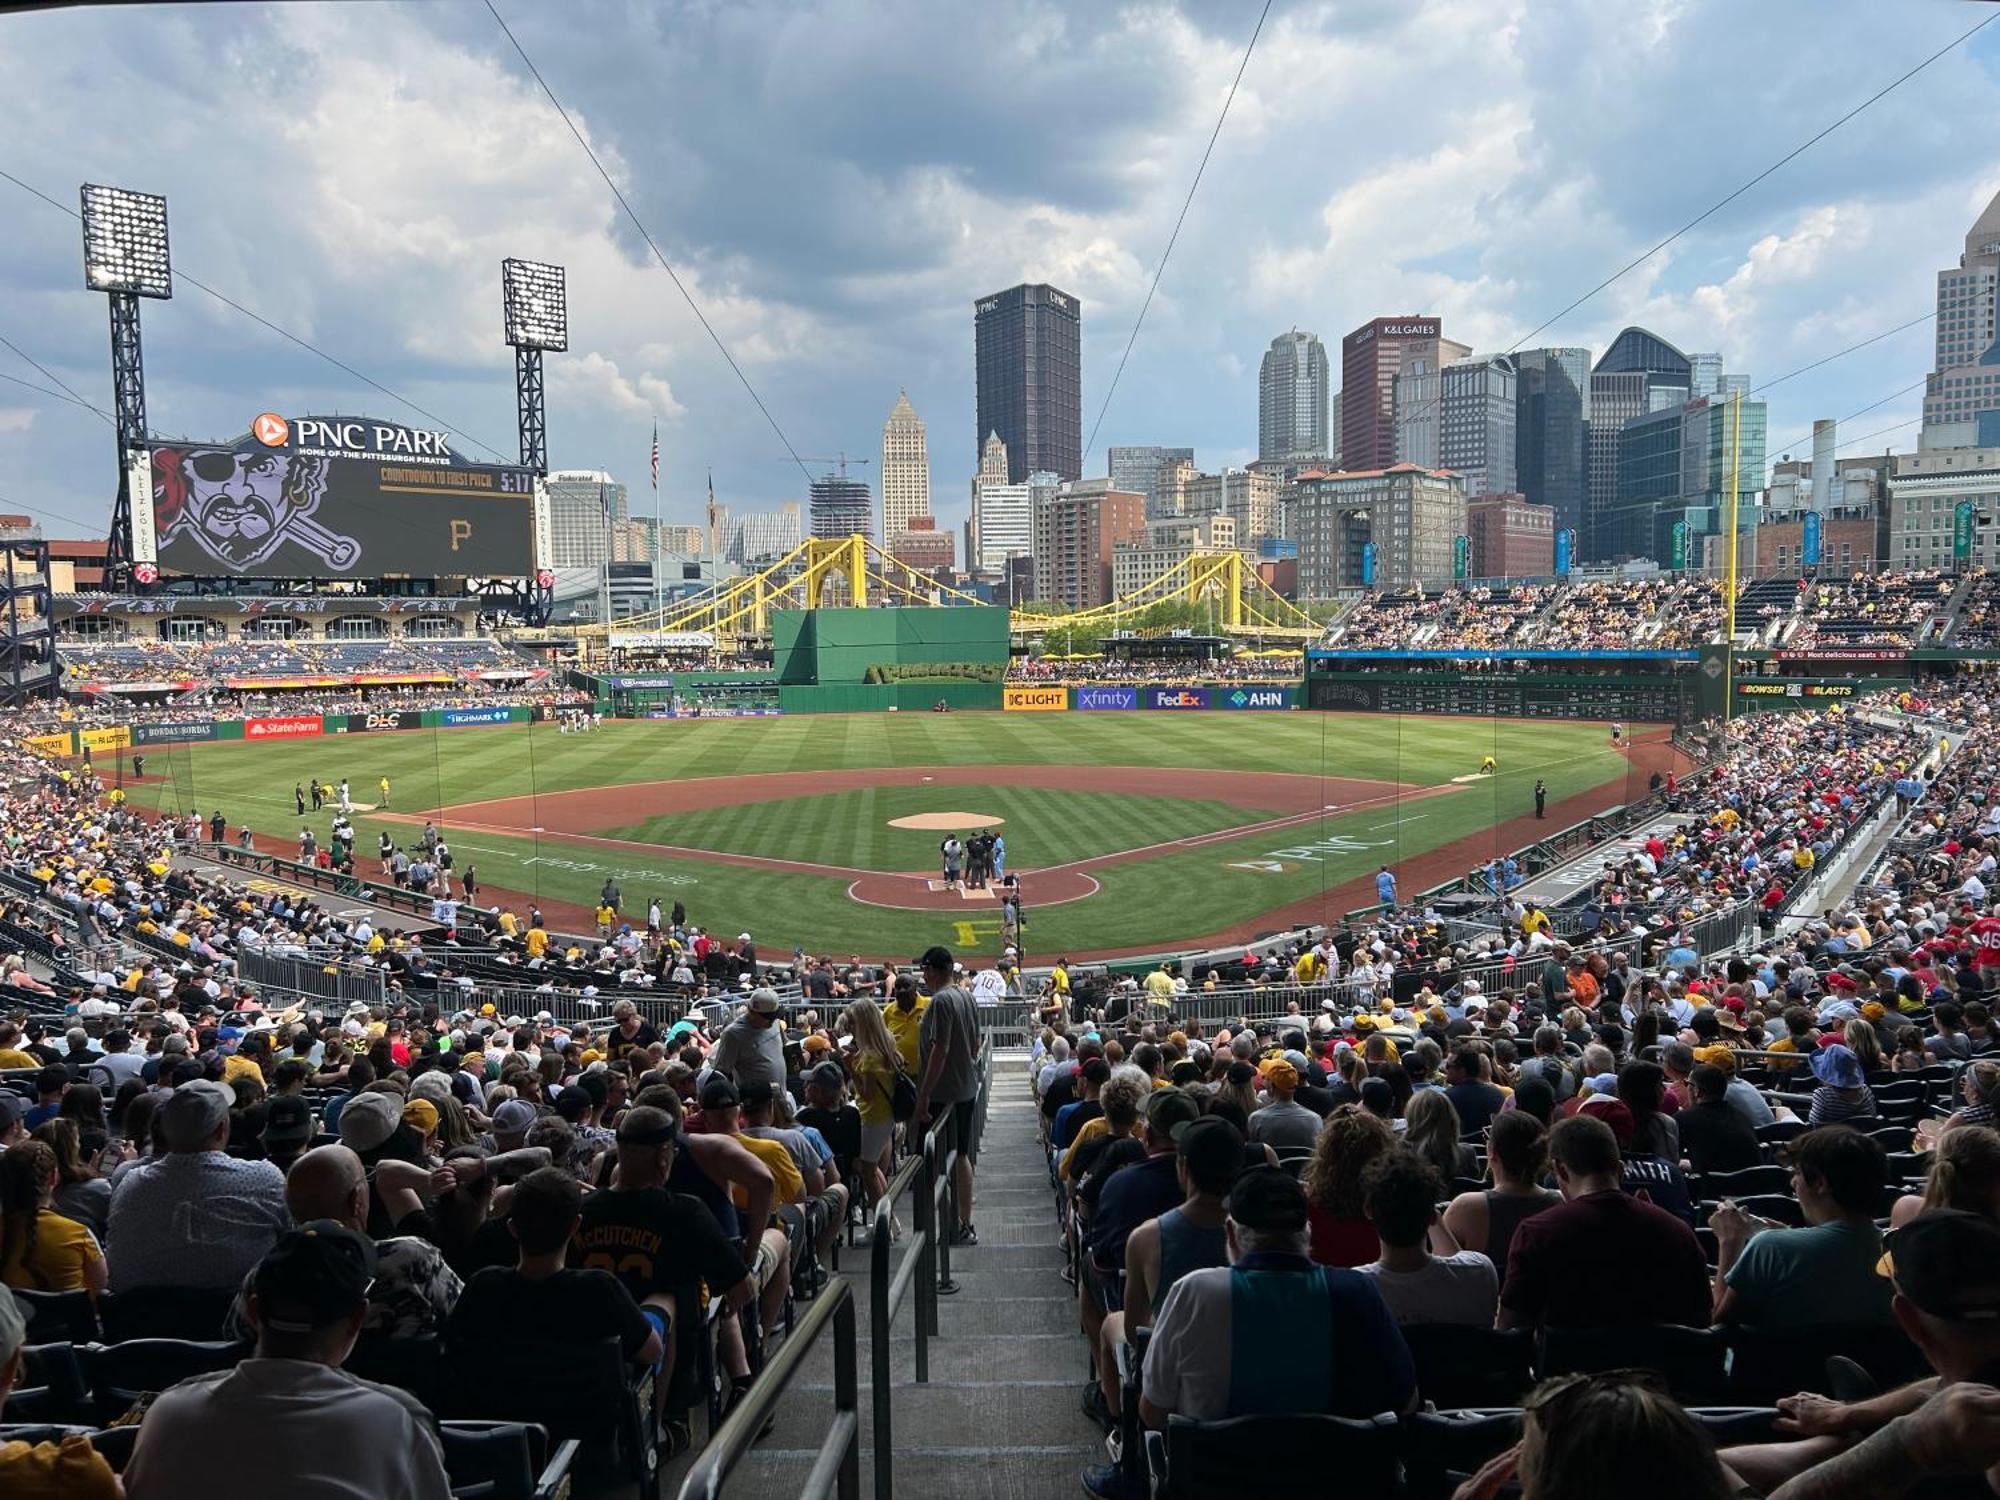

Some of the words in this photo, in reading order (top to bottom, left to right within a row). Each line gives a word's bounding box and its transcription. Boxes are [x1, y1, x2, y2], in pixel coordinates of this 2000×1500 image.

[1050, 291, 1067, 308] UPMC
[1384, 325, 1402, 334] K&L
[1403, 325, 1434, 334] GATES
[294, 420, 365, 449] PNC
[372, 427, 451, 455] PARK
[300, 447, 325, 457] HOME
[328, 449, 340, 457] OF
[343, 450, 360, 459] THE
[362, 451, 415, 463] PITTSBURGH
[416, 456, 450, 465] PIRATES
[381, 467, 434, 483] COUNTDOWN
[436, 471, 446, 484] TO
[447, 472, 468, 486] FIRST
[469, 473, 492, 488] PITCH
[500, 473, 529, 492] 5:17
[451, 520, 472, 551] P
[1082, 690, 1132, 706] xfinity
[1745, 685, 1785, 695] BOWSER
[1813, 686, 1852, 696] BLASTS
[1026, 693, 1062, 705] LIGHT
[1157, 691, 1200, 707] FedEx
[1249, 692, 1282, 706] AHN
[365, 714, 400, 729] DLC
[98, 736, 106, 745] PA
[982, 975, 995, 990] 10
